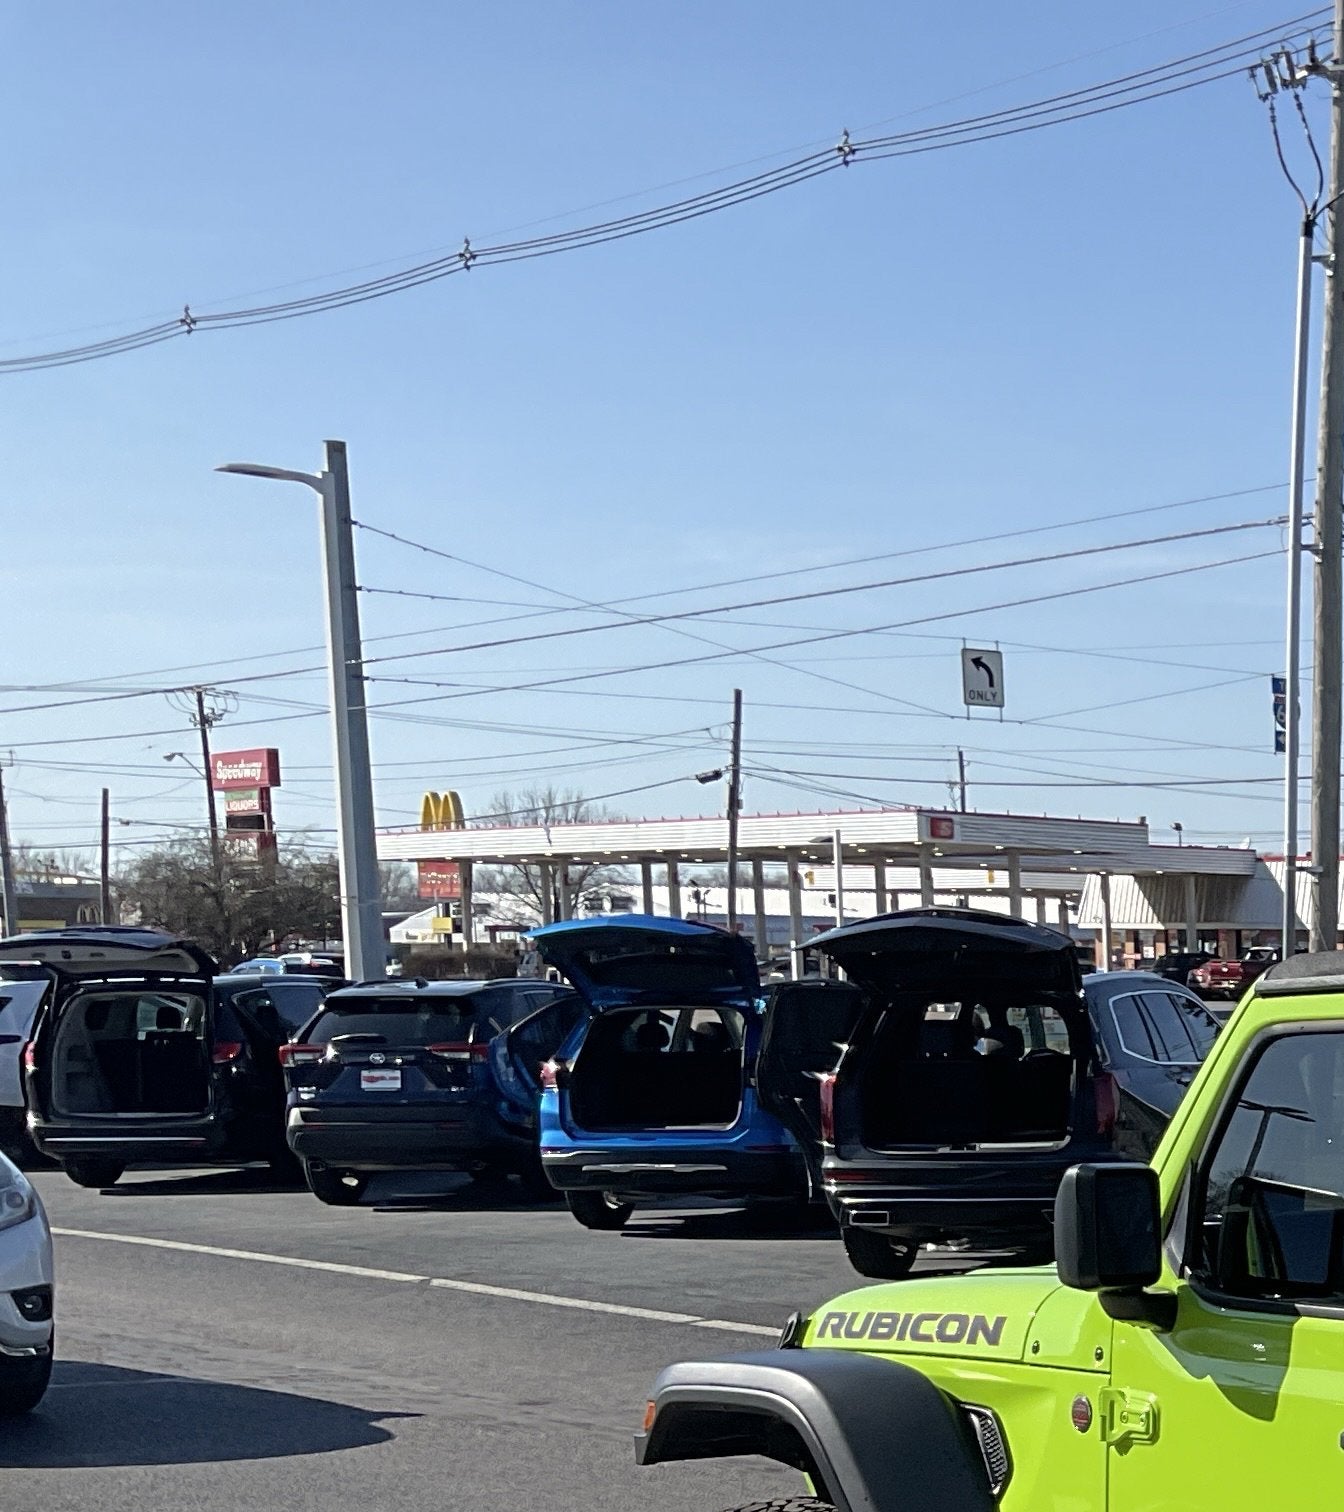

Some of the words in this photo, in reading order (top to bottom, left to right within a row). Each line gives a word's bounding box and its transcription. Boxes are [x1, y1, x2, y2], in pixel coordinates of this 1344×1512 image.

[968, 690, 998, 702] ONLY
[216, 759, 262, 784] Speedway
[226, 799, 259, 811] LIQUORS
[817, 1311, 1008, 1346] RUBICON
